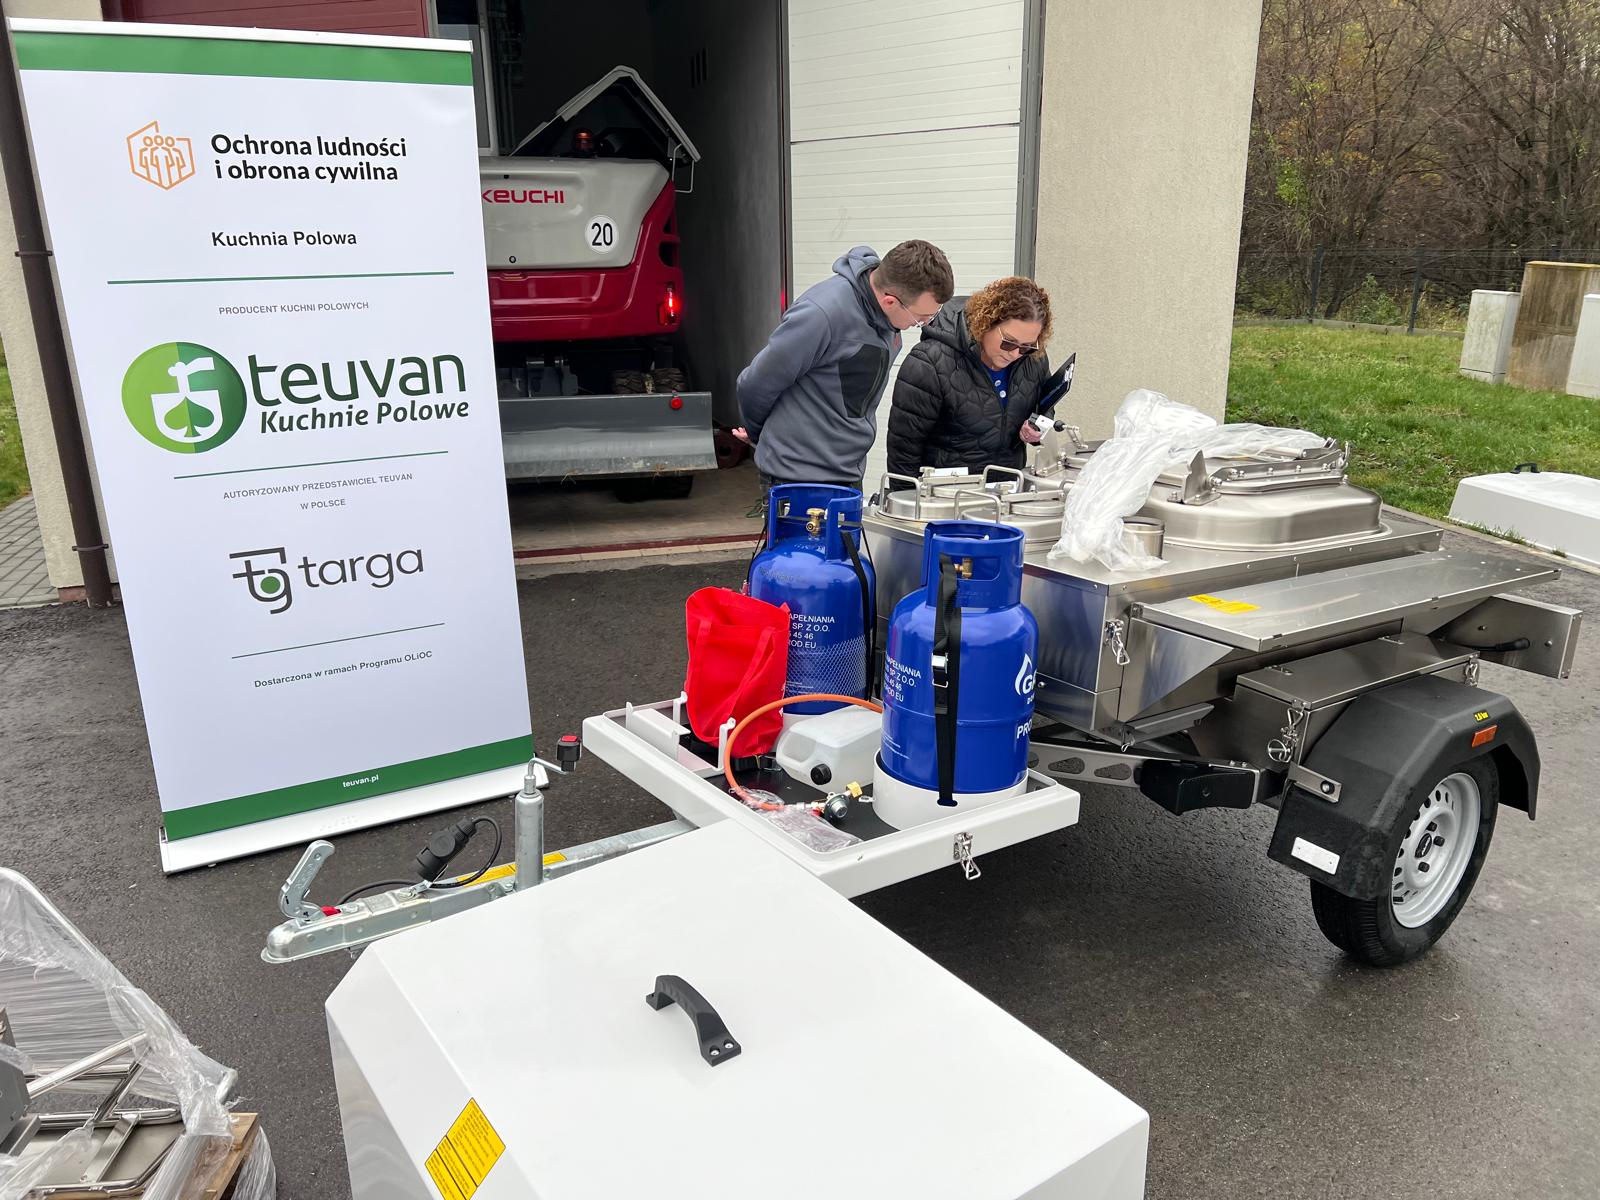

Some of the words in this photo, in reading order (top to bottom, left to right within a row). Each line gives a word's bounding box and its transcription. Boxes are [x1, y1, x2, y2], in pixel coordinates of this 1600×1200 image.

[211, 134, 312, 155] Ochrona
[317, 136, 407, 157] ludności
[215, 160, 222, 178] i
[228, 160, 310, 180] obrona
[315, 161, 398, 184] cywilna
[211, 232, 288, 247] Kuchnia
[293, 231, 357, 246] Polowa
[591, 222, 614, 247] 20
[218, 305, 278, 315] PRODUCENT
[280, 303, 316, 313] KUCHNI
[318, 301, 370, 312] POLOWYCH
[247, 354, 467, 407] teuvan
[260, 405, 369, 434] Kuchnie
[376, 400, 469, 425] Polowe
[223, 484, 300, 500] AUTORYZOWANY
[302, 476, 377, 491] PRZEDSTAWICIEL
[378, 473, 413, 483] TEUVAN
[300, 502, 309, 510] W
[311, 498, 346, 510] POLSCE
[297, 549, 424, 589] targa
[254, 672, 312, 688] Dostarczona
[324, 664, 358, 676] ramach
[359, 657, 403, 670] Programu
[404, 650, 433, 662] OLiOC
[342, 774, 379, 788] teuvan.pl
